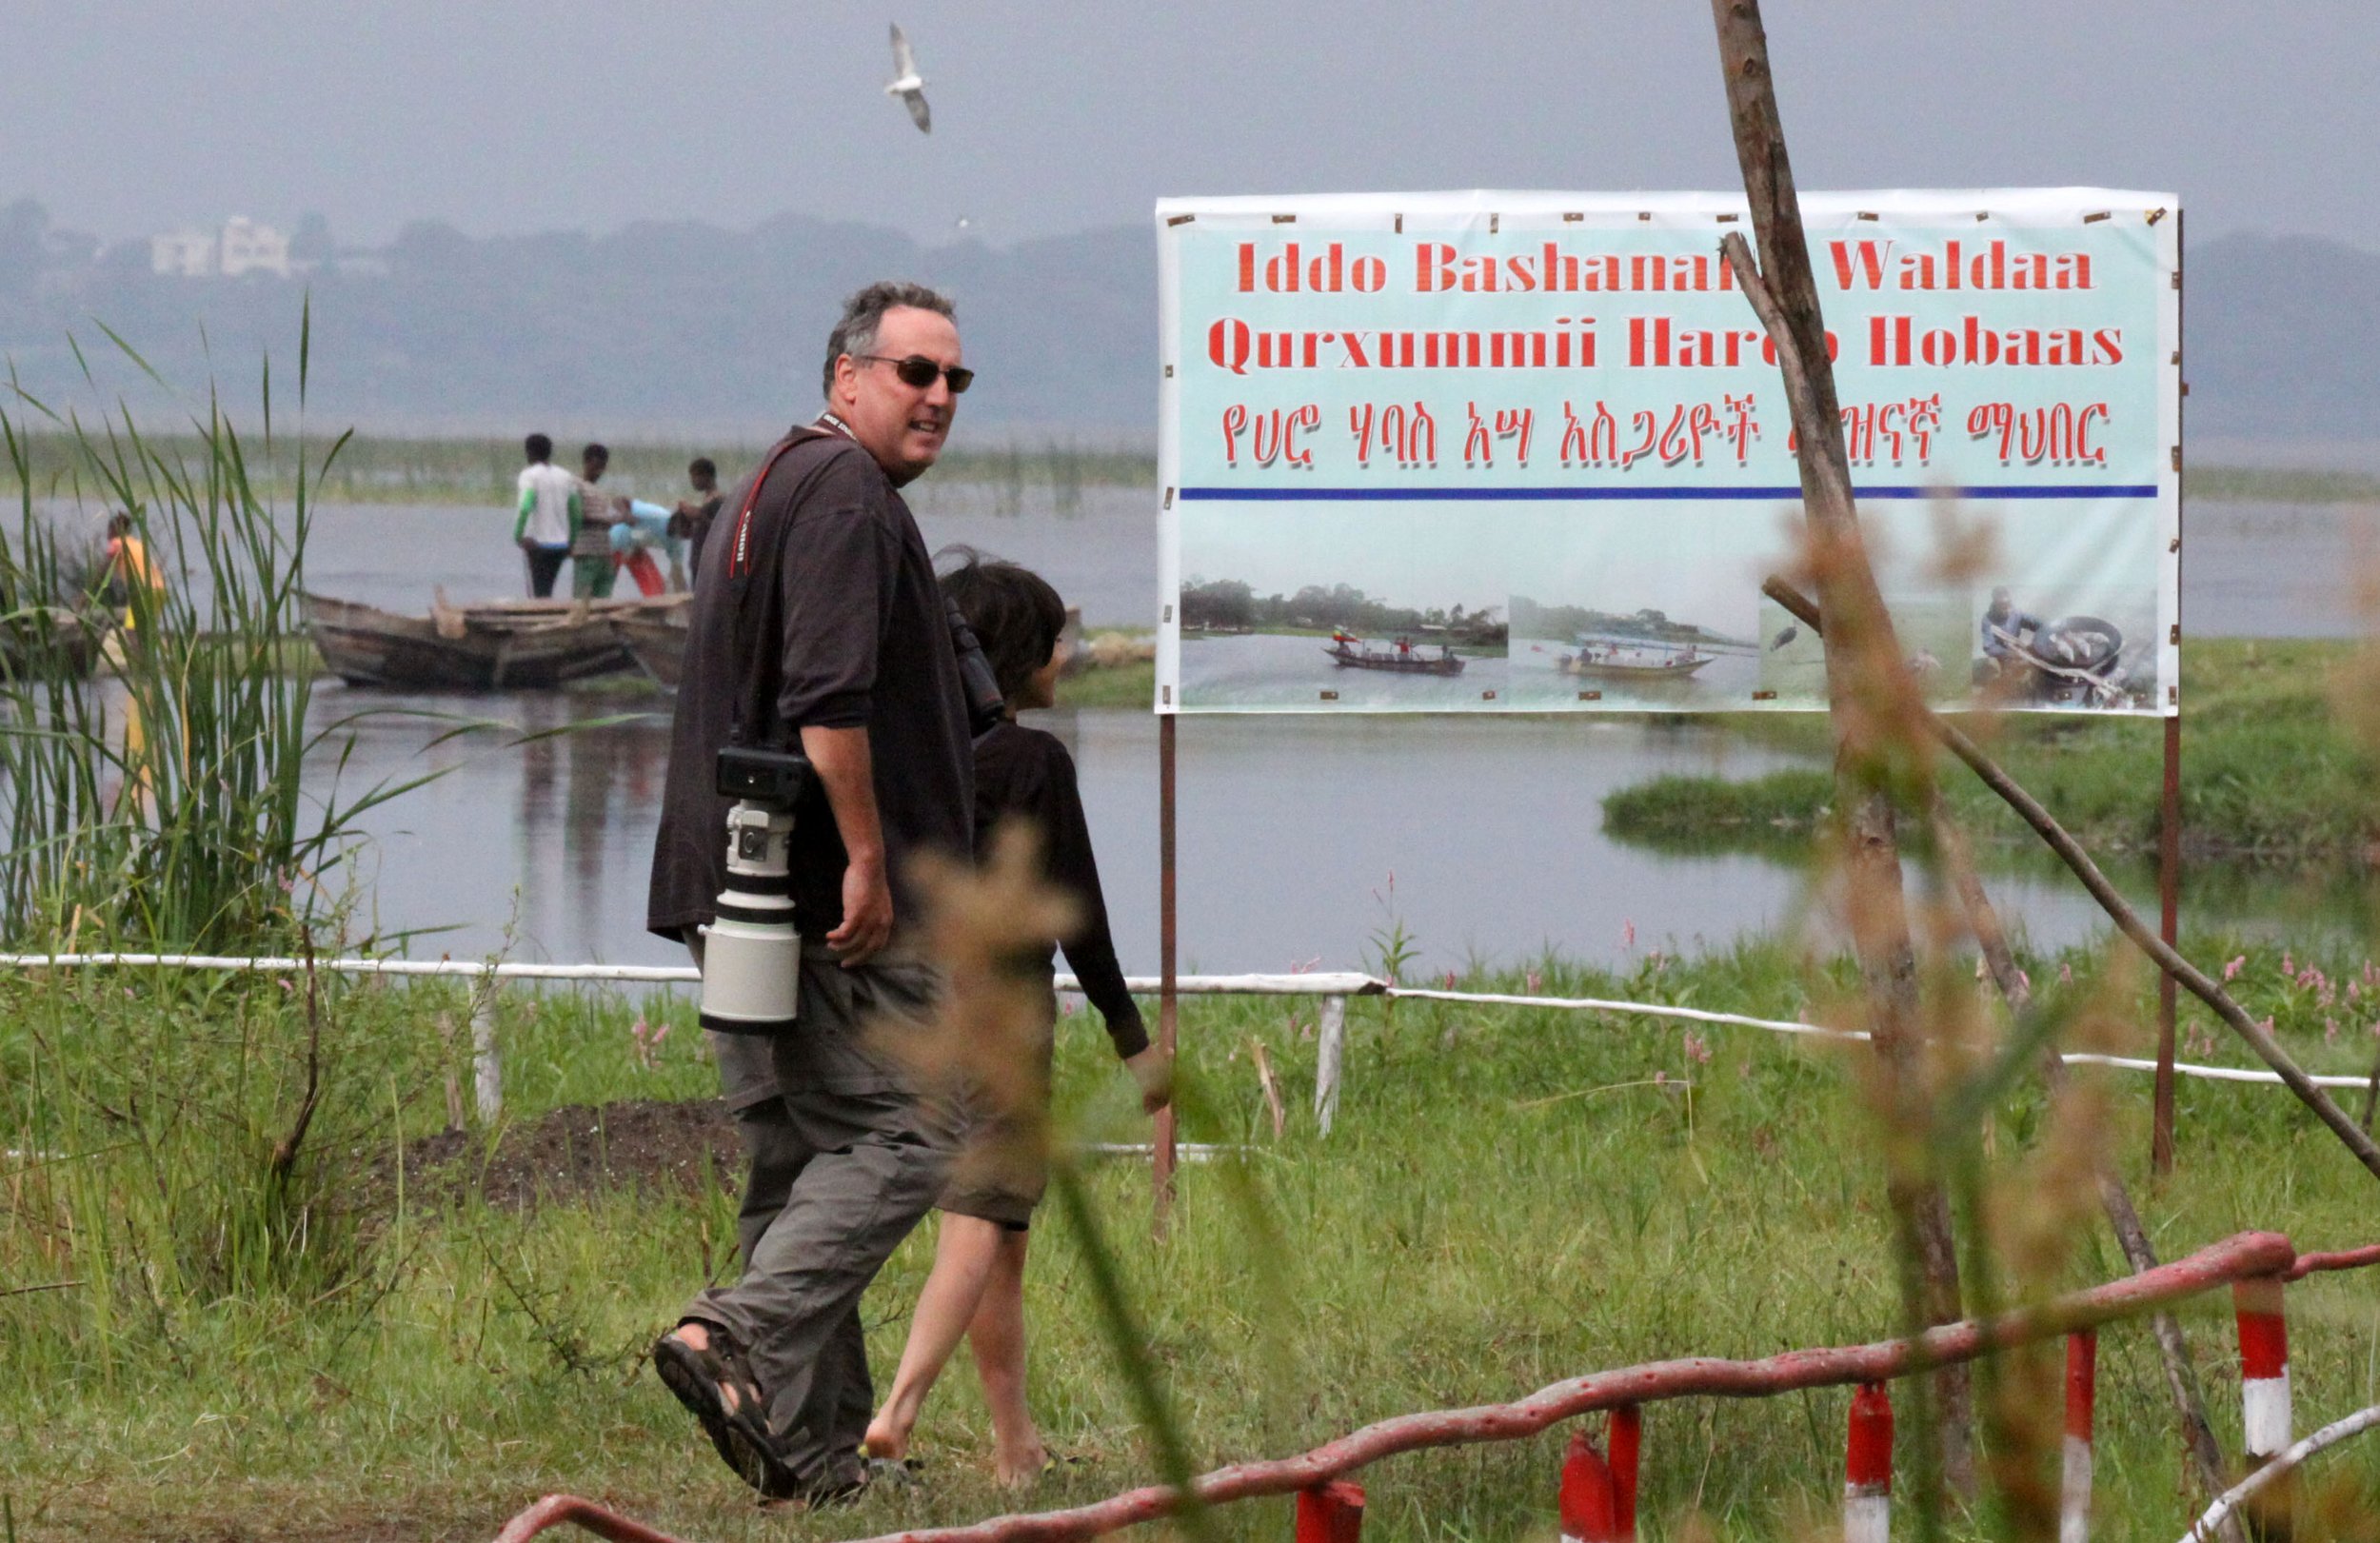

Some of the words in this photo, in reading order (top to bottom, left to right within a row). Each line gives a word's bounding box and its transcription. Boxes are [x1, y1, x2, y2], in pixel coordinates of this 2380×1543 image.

[1237, 242, 1388, 293] Iddo
[1413, 241, 1761, 293] Bashana
[1826, 239, 2097, 291] Waldaa
[1207, 316, 1601, 376] Qurxummii
[1865, 314, 2124, 367] Hobaas
[1221, 403, 1321, 465] የሀሮ
[1348, 400, 1437, 465] ሃባስ
[1463, 400, 1535, 464] አሣ
[1787, 392, 1941, 462] ዝናኛ
[1965, 401, 2110, 464] ማህበር
